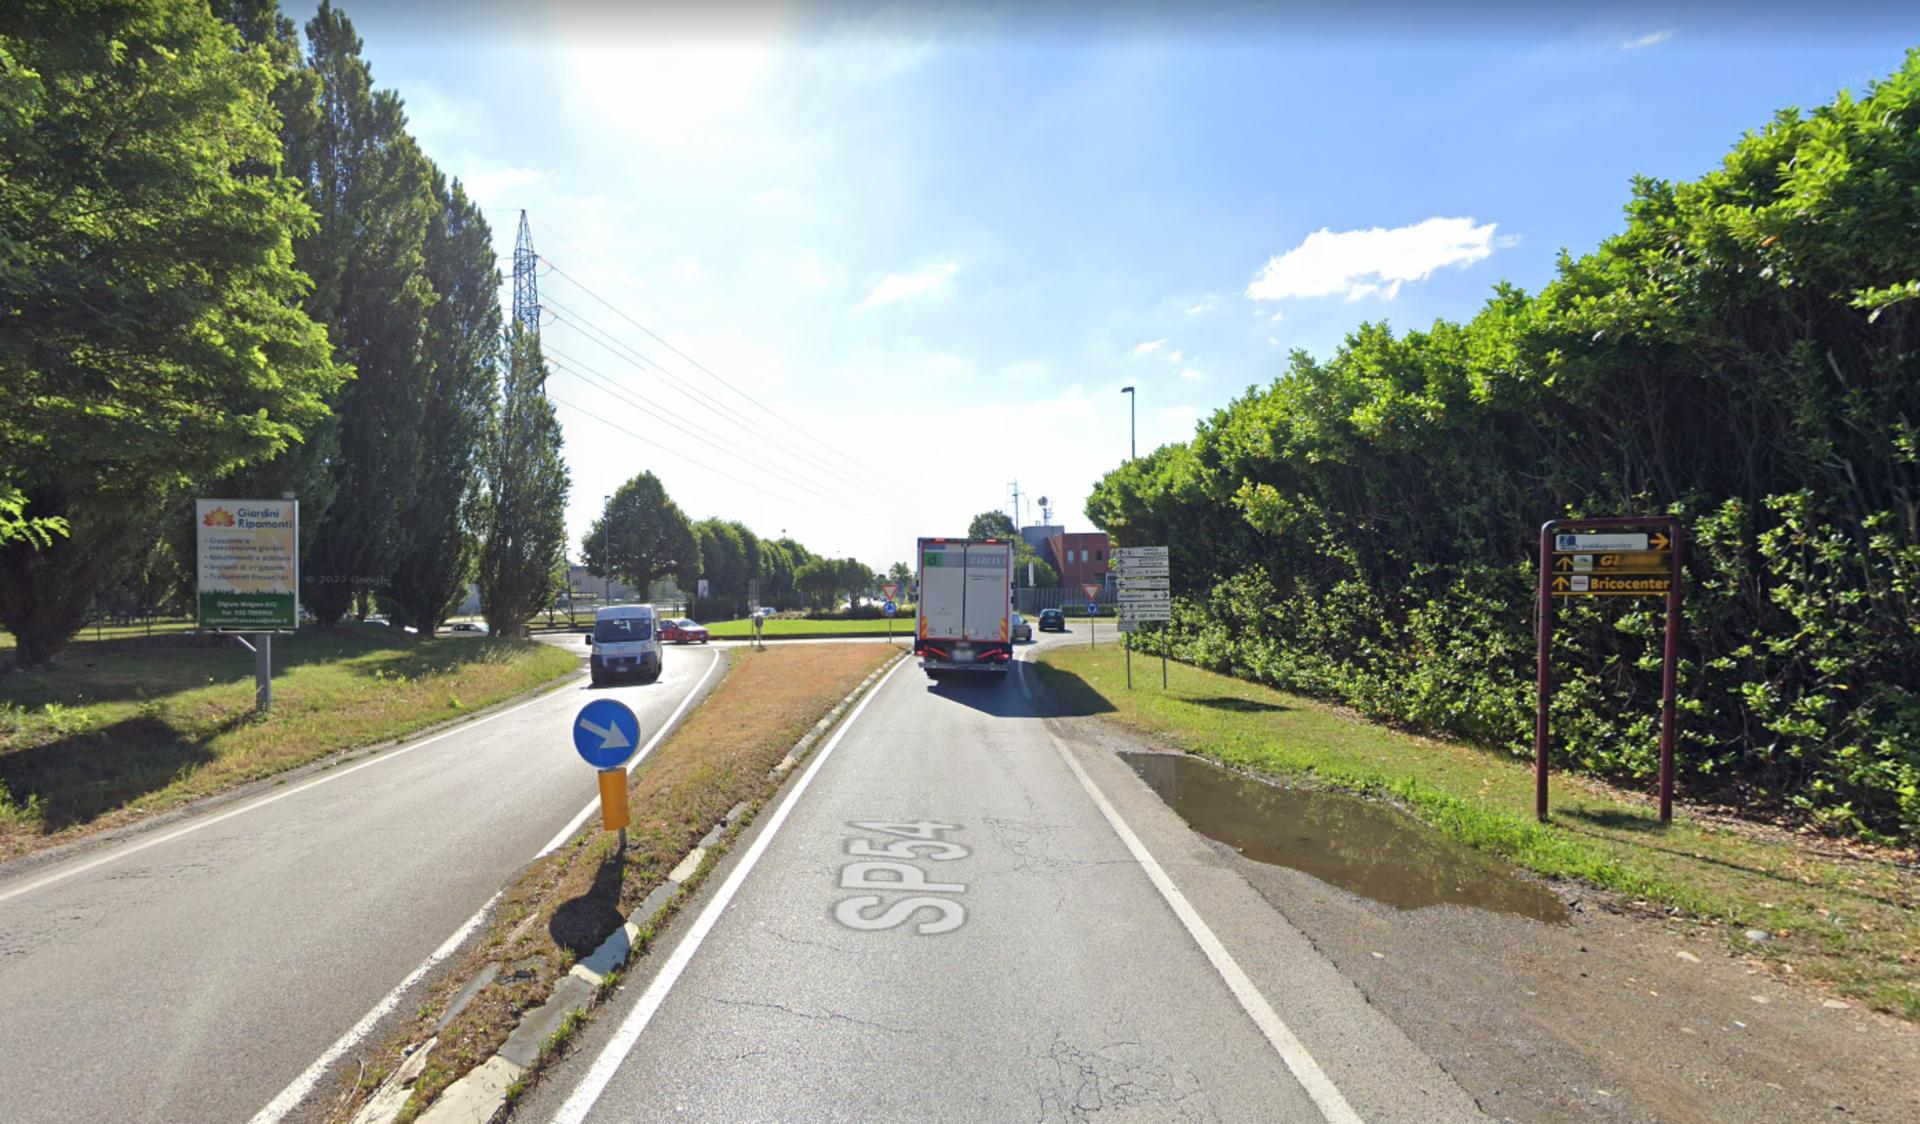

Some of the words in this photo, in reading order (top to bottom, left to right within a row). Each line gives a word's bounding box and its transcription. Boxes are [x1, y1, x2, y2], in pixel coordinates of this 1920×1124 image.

[237, 508, 280, 518] Giardini
[237, 518, 293, 529] Ripamonti
[1590, 577, 1670, 589] Bricocenter
